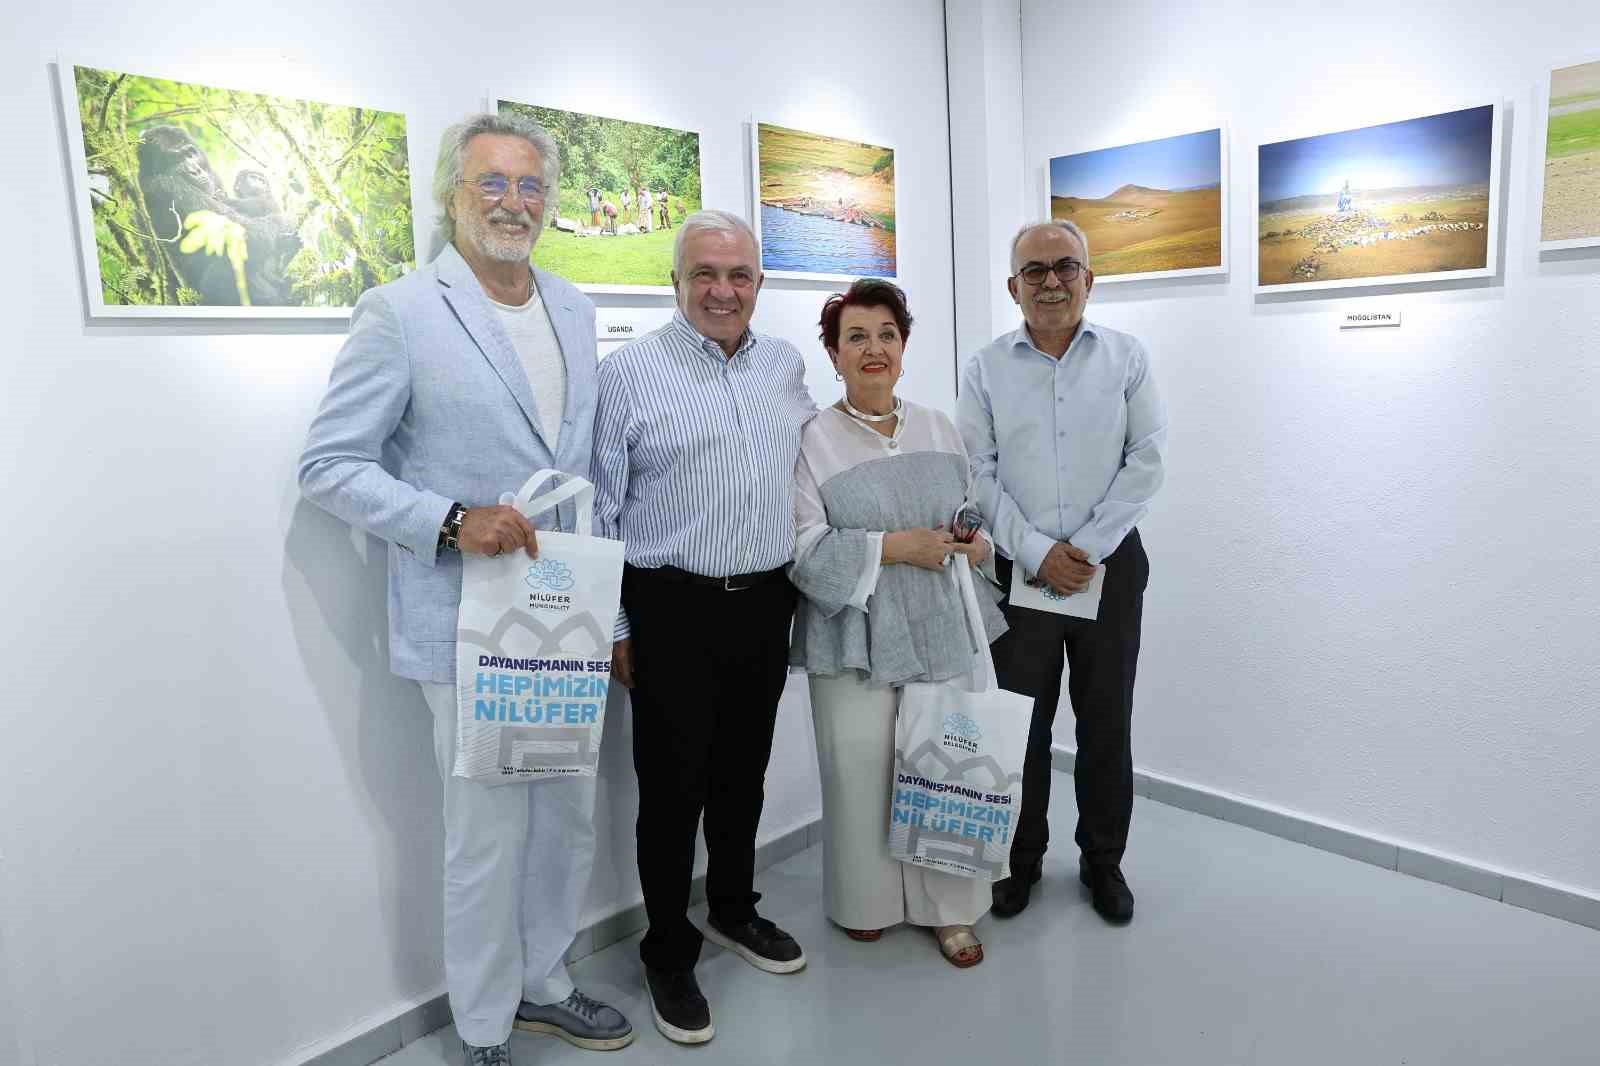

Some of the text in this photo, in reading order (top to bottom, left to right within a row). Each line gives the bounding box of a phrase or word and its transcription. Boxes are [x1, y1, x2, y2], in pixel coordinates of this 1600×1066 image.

[529, 592, 570, 604] NİLÜFER
[478, 655, 584, 673] DAYANIŞMANIN
[984, 793, 1012, 805] SESİ
[895, 788, 1010, 826] HEPİMİZİN
